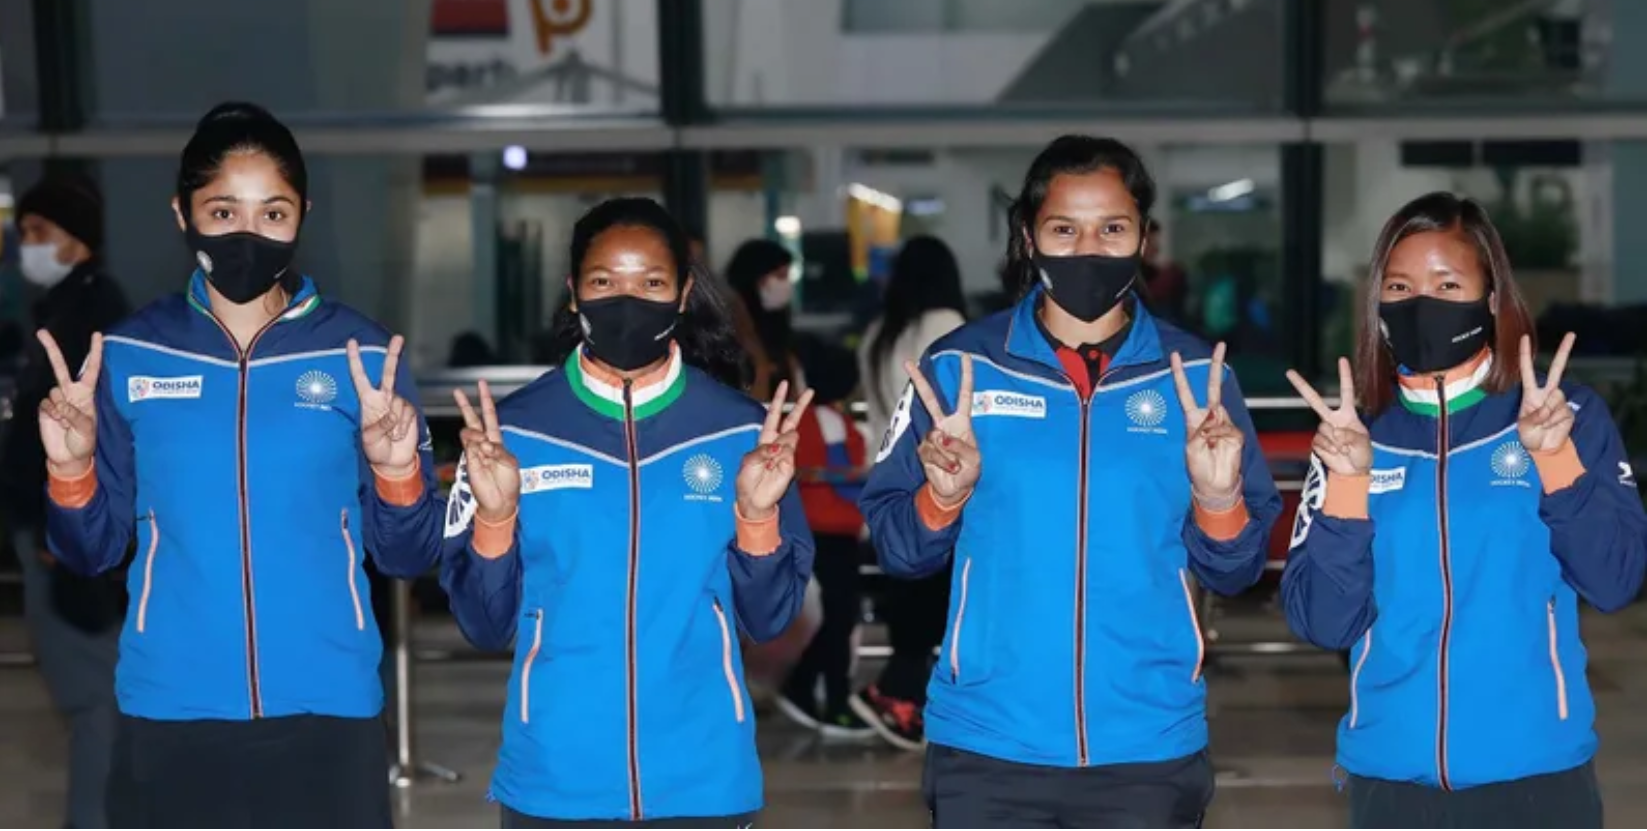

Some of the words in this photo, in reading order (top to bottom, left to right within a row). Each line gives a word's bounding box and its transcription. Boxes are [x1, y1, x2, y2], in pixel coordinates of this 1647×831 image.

[152, 380, 200, 391] ODISHA
[994, 395, 1043, 408] ODISHA
[541, 468, 590, 480] ODISHA
[1370, 471, 1404, 485] DISHA
